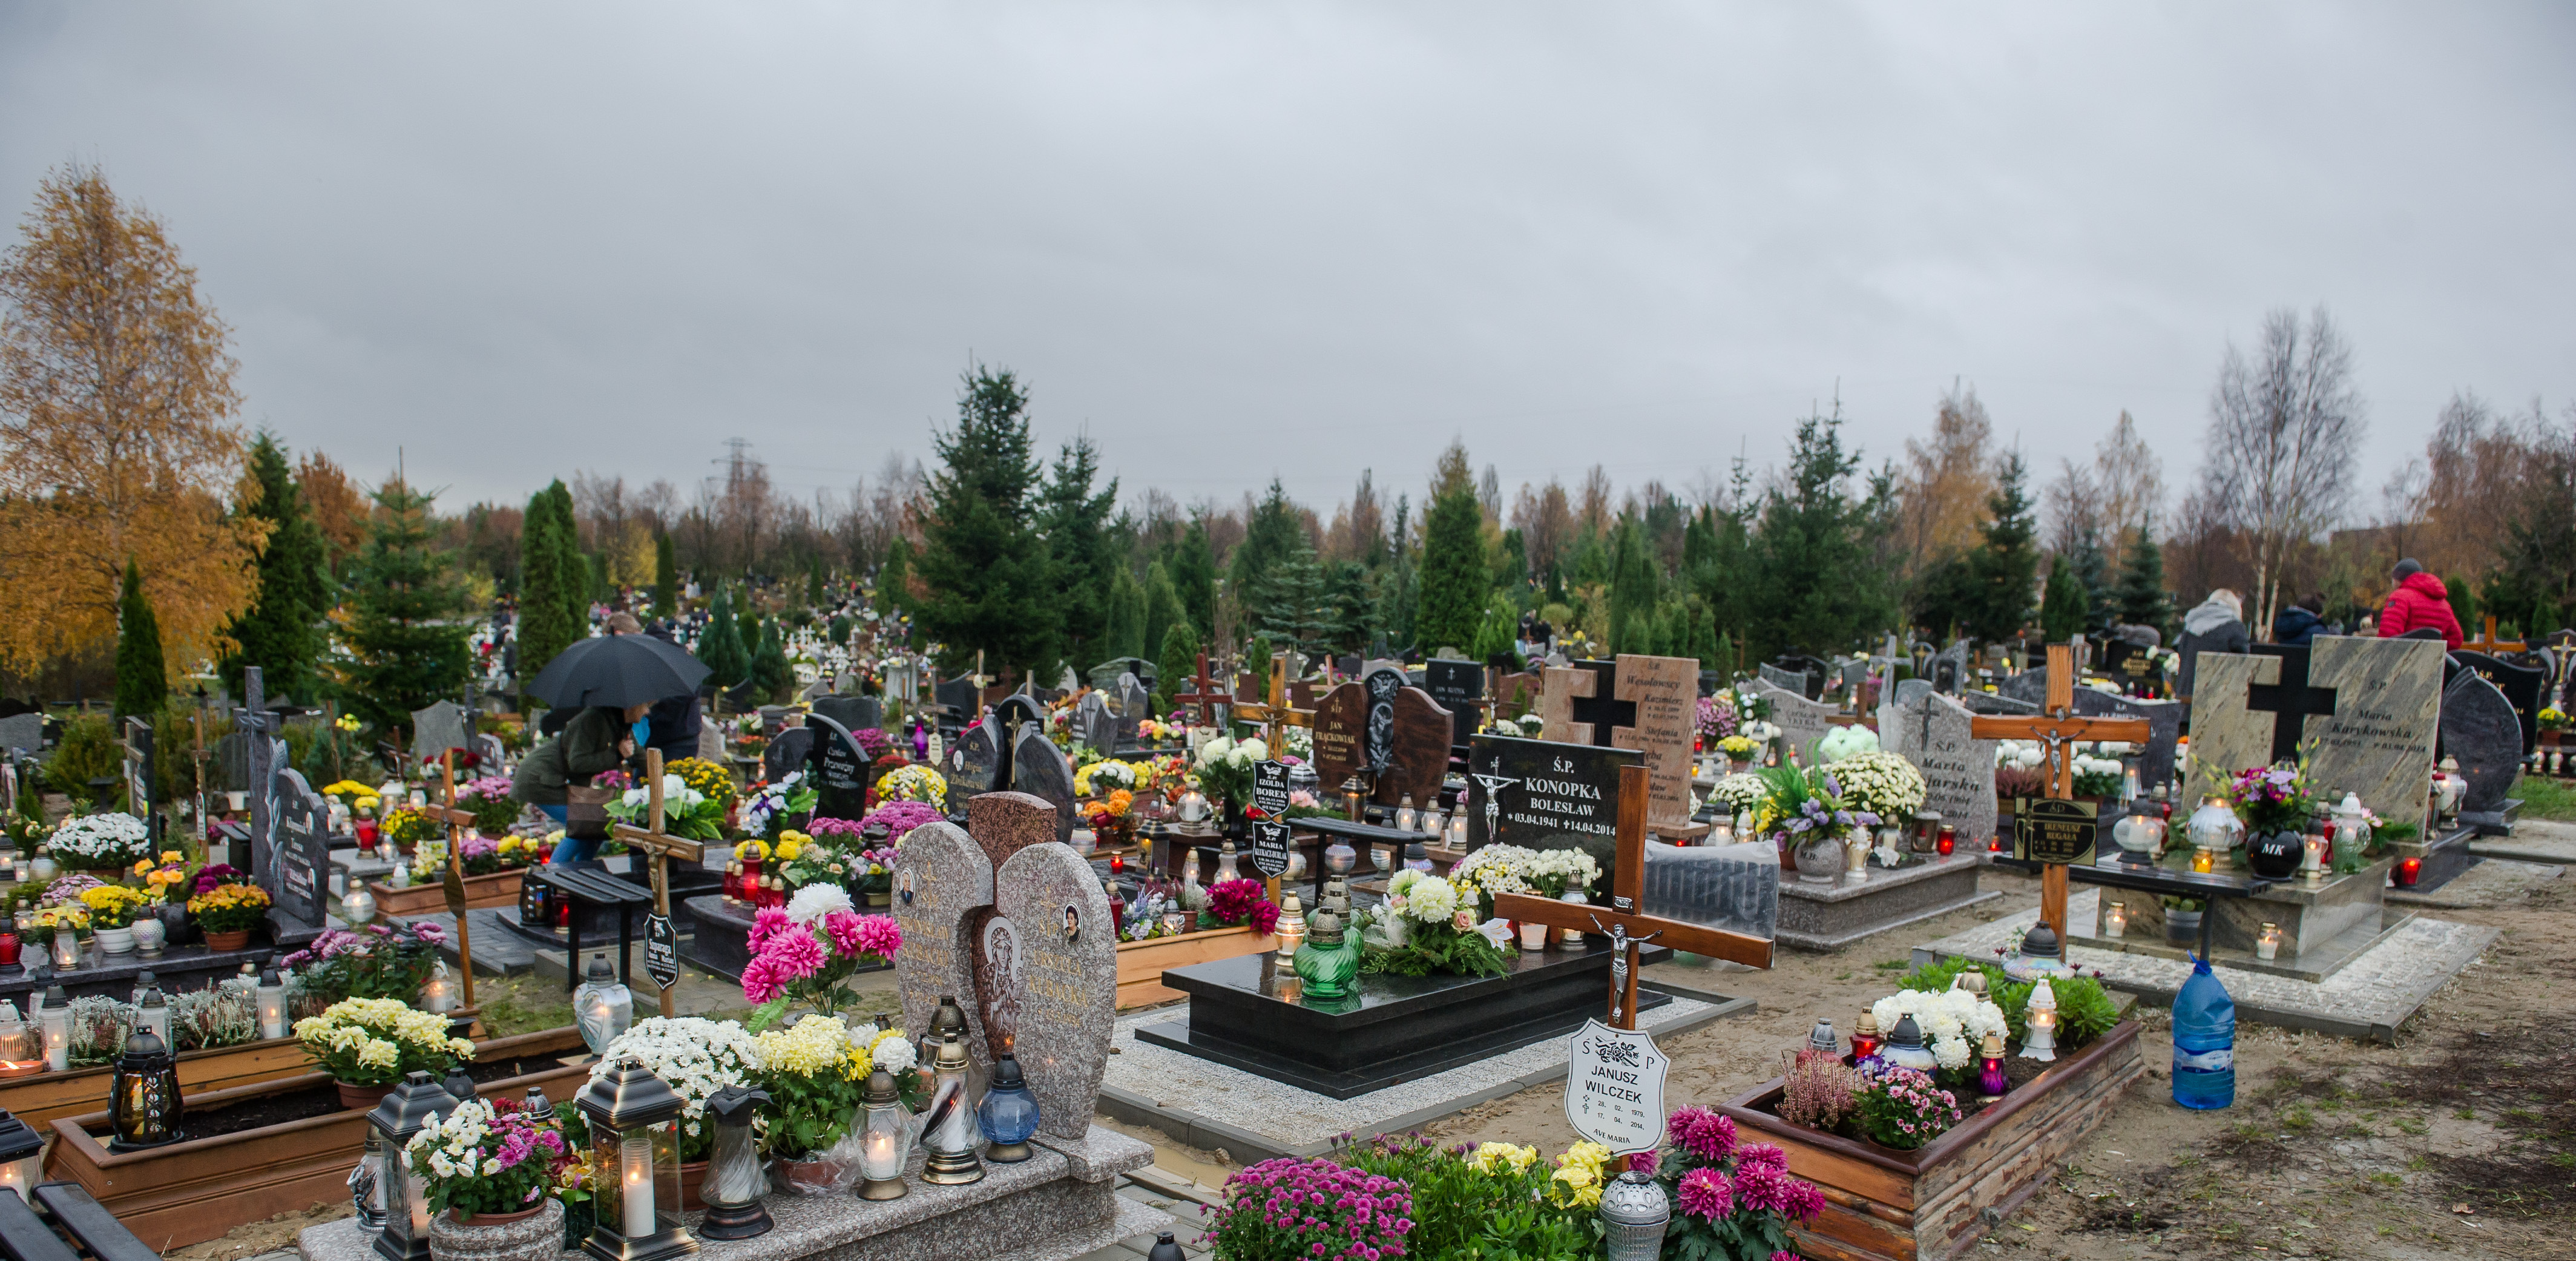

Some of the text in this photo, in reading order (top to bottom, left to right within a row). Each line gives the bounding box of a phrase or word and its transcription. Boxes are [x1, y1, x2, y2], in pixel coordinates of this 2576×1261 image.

[2359, 710, 2392, 720] Maria
[1330, 721, 1342, 730] JAN
[1645, 726, 1678, 737] Stefania
[1553, 756, 1574, 774] Ś.P.
[1259, 779, 1284, 788] IZOLDA
[1525, 777, 1602, 800] KONOPKA
[1256, 788, 1287, 799] BOREK
[1530, 797, 1595, 816] BOLESŁAW
[1514, 813, 1616, 836] 03.04.1941 14.04.2014
[2045, 823, 2081, 833] IRENEUSZ
[1259, 841, 1283, 850] MARIA
[2261, 843, 2285, 856] MK
[902, 940, 949, 967] KUBACKI
[1034, 949, 1082, 976] URSZULA
[1029, 975, 1089, 1007] KUBACKA
[1582, 1038, 1654, 1069] Ś P
[1591, 1065, 1638, 1085] JANUSZ
[1585, 1079, 1642, 1104] WILCZEK
[1631, 1122, 1644, 1130] 2014.
[1594, 1128, 1631, 1144] AVE MARIA
